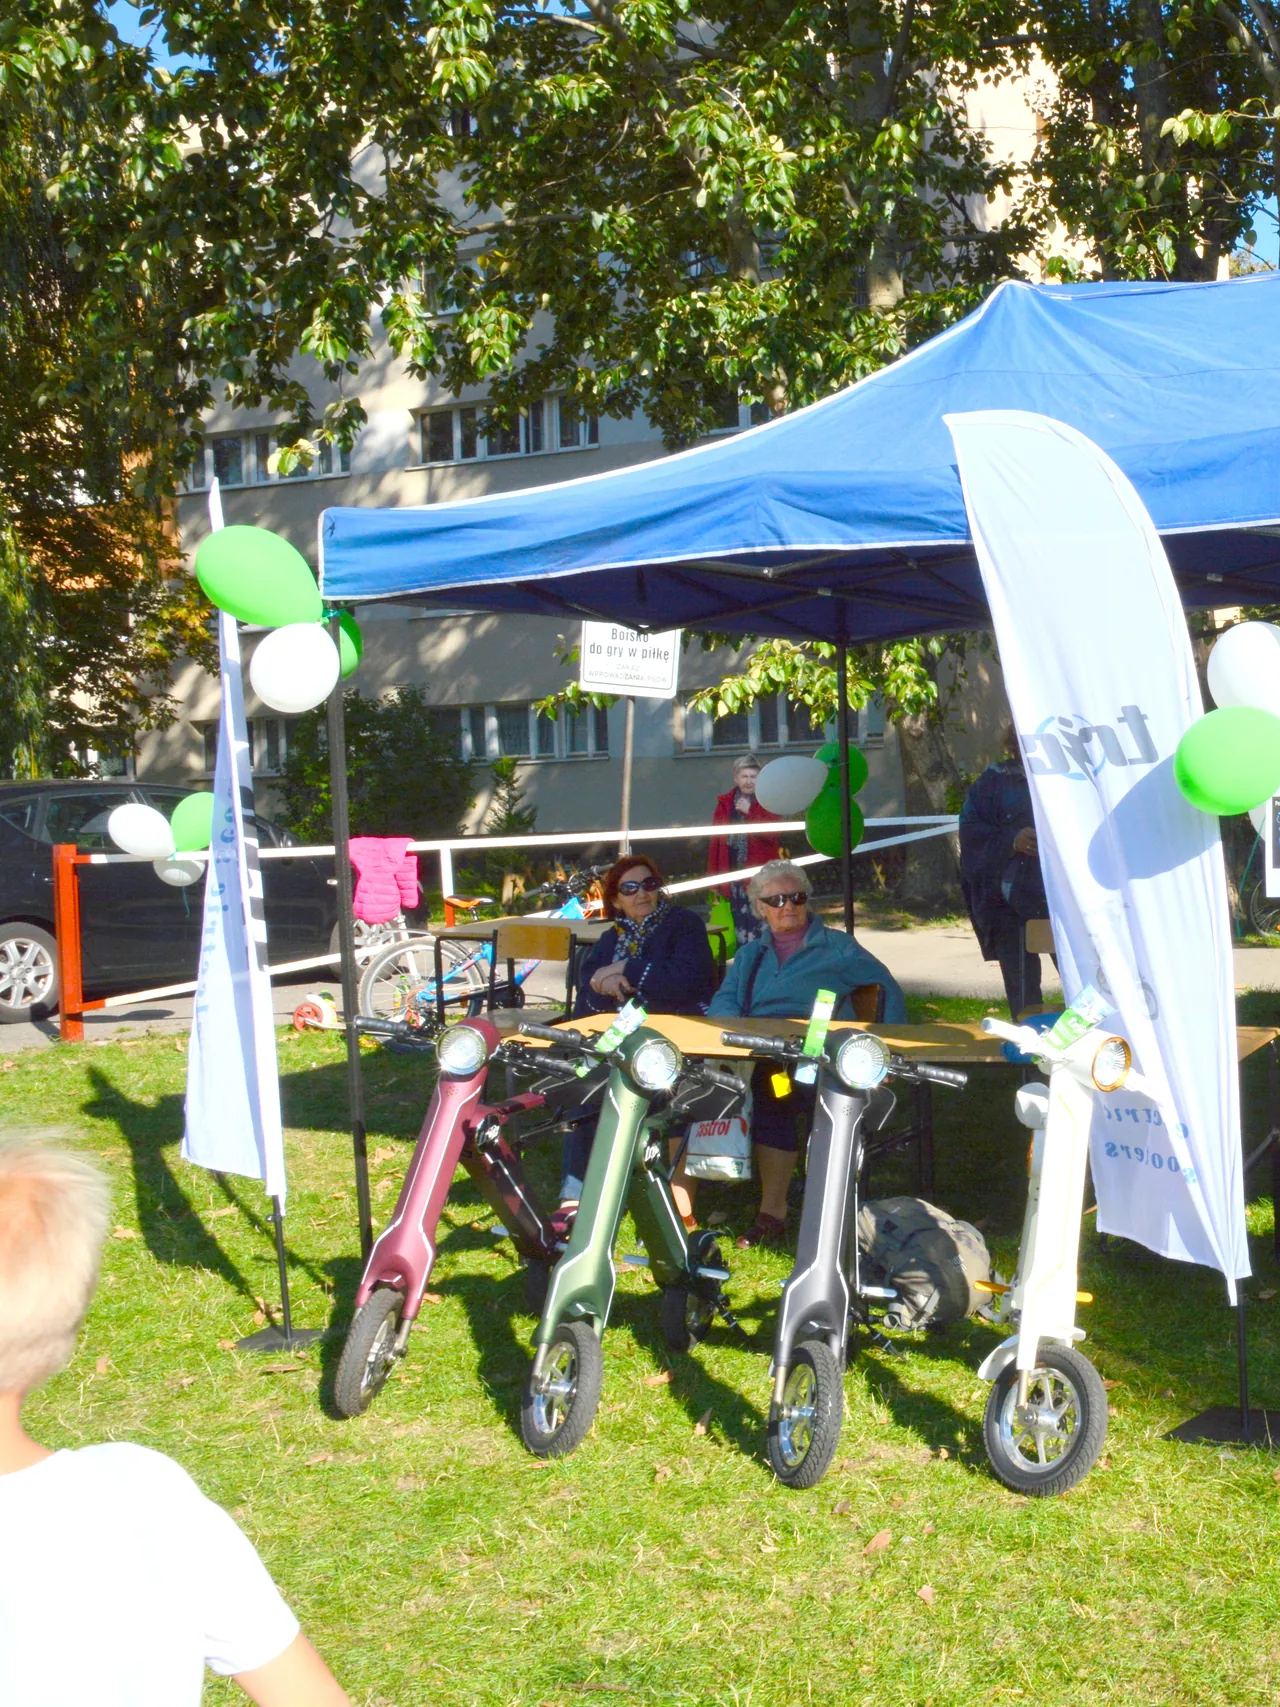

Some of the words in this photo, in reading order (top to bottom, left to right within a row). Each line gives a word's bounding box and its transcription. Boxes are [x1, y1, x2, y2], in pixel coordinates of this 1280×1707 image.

[589, 642, 602, 655] do
[606, 645, 624, 658] gry
[628, 647, 637, 658] w
[641, 646, 670, 664] piłkę
[695, 1119, 732, 1138] astrol
